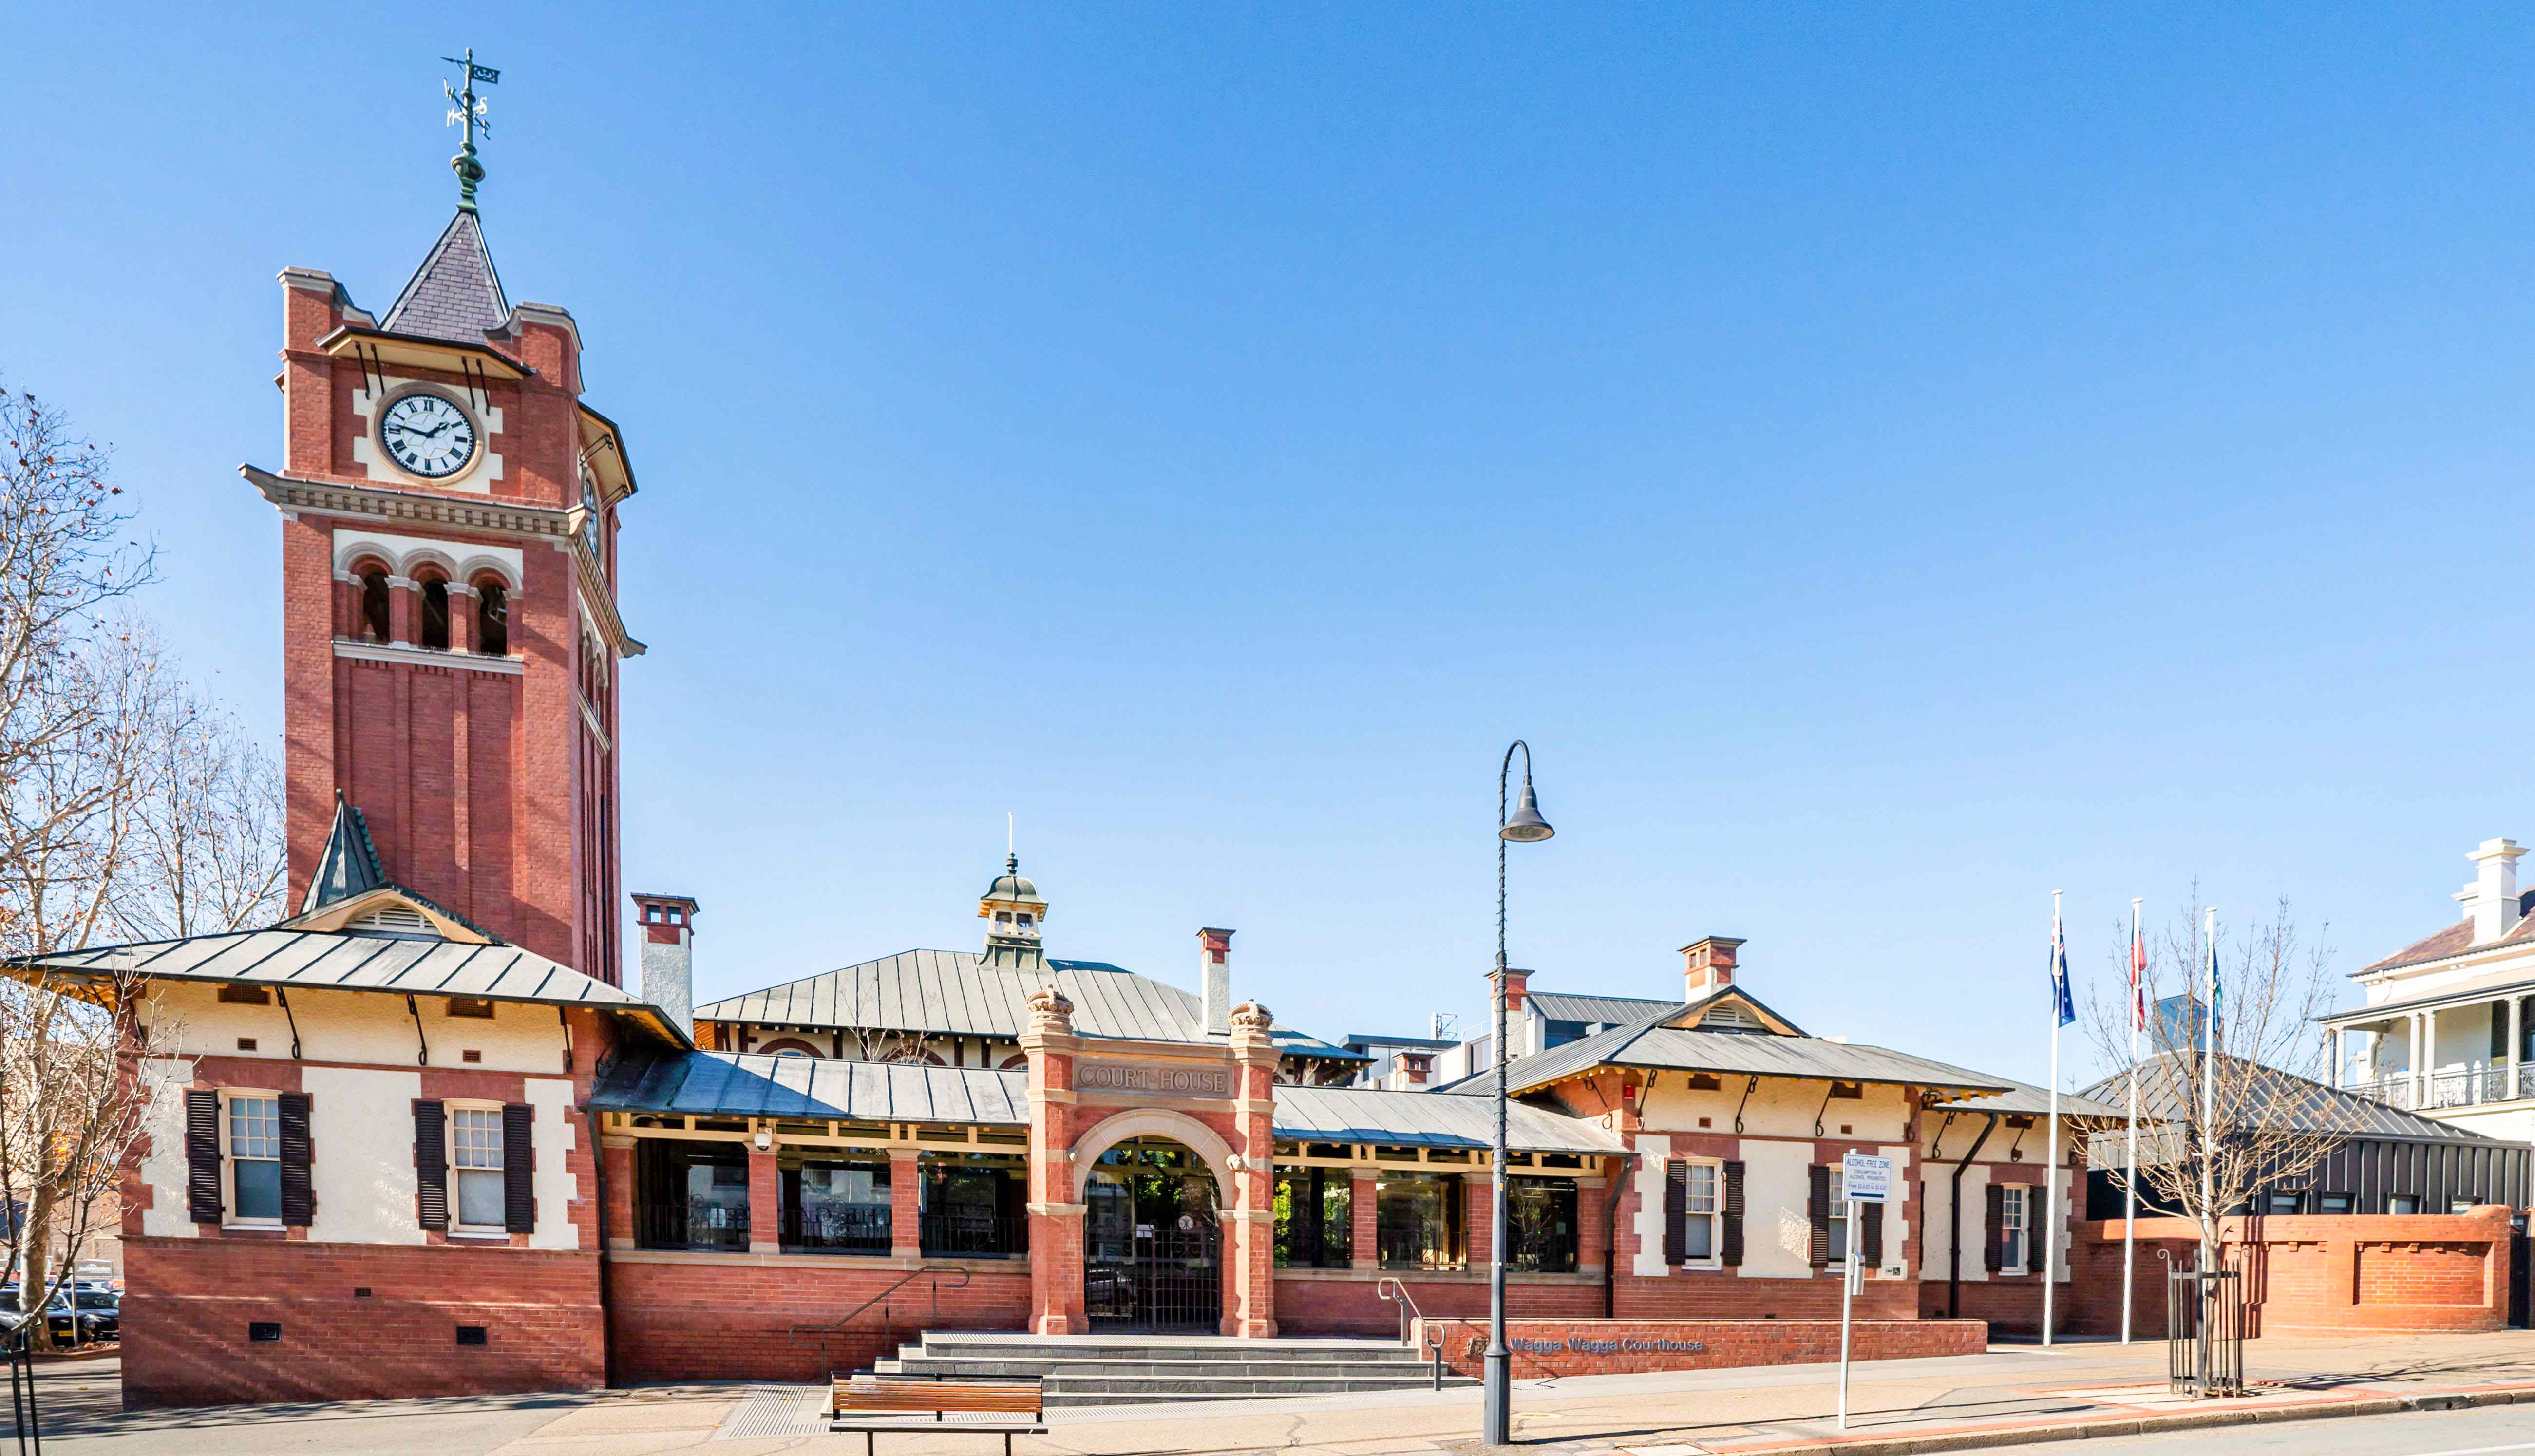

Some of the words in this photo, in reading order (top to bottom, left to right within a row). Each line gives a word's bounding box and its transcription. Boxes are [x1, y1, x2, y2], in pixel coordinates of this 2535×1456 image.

[479, 97, 488, 115] S
[405, 401, 418, 414] XI
[423, 399, 434, 413] XII
[441, 407, 449, 417] I
[1080, 1066, 1150, 1089] COURT
[1160, 1070, 1225, 1093] HOUSE
[1847, 1158, 1865, 1167] ALCOHOL
[1878, 1160, 1890, 1169] ZONE
[1509, 1337, 1562, 1353] Wagga
[1567, 1337, 1619, 1353] Wagga
[1622, 1337, 1704, 1352] Courthouse
